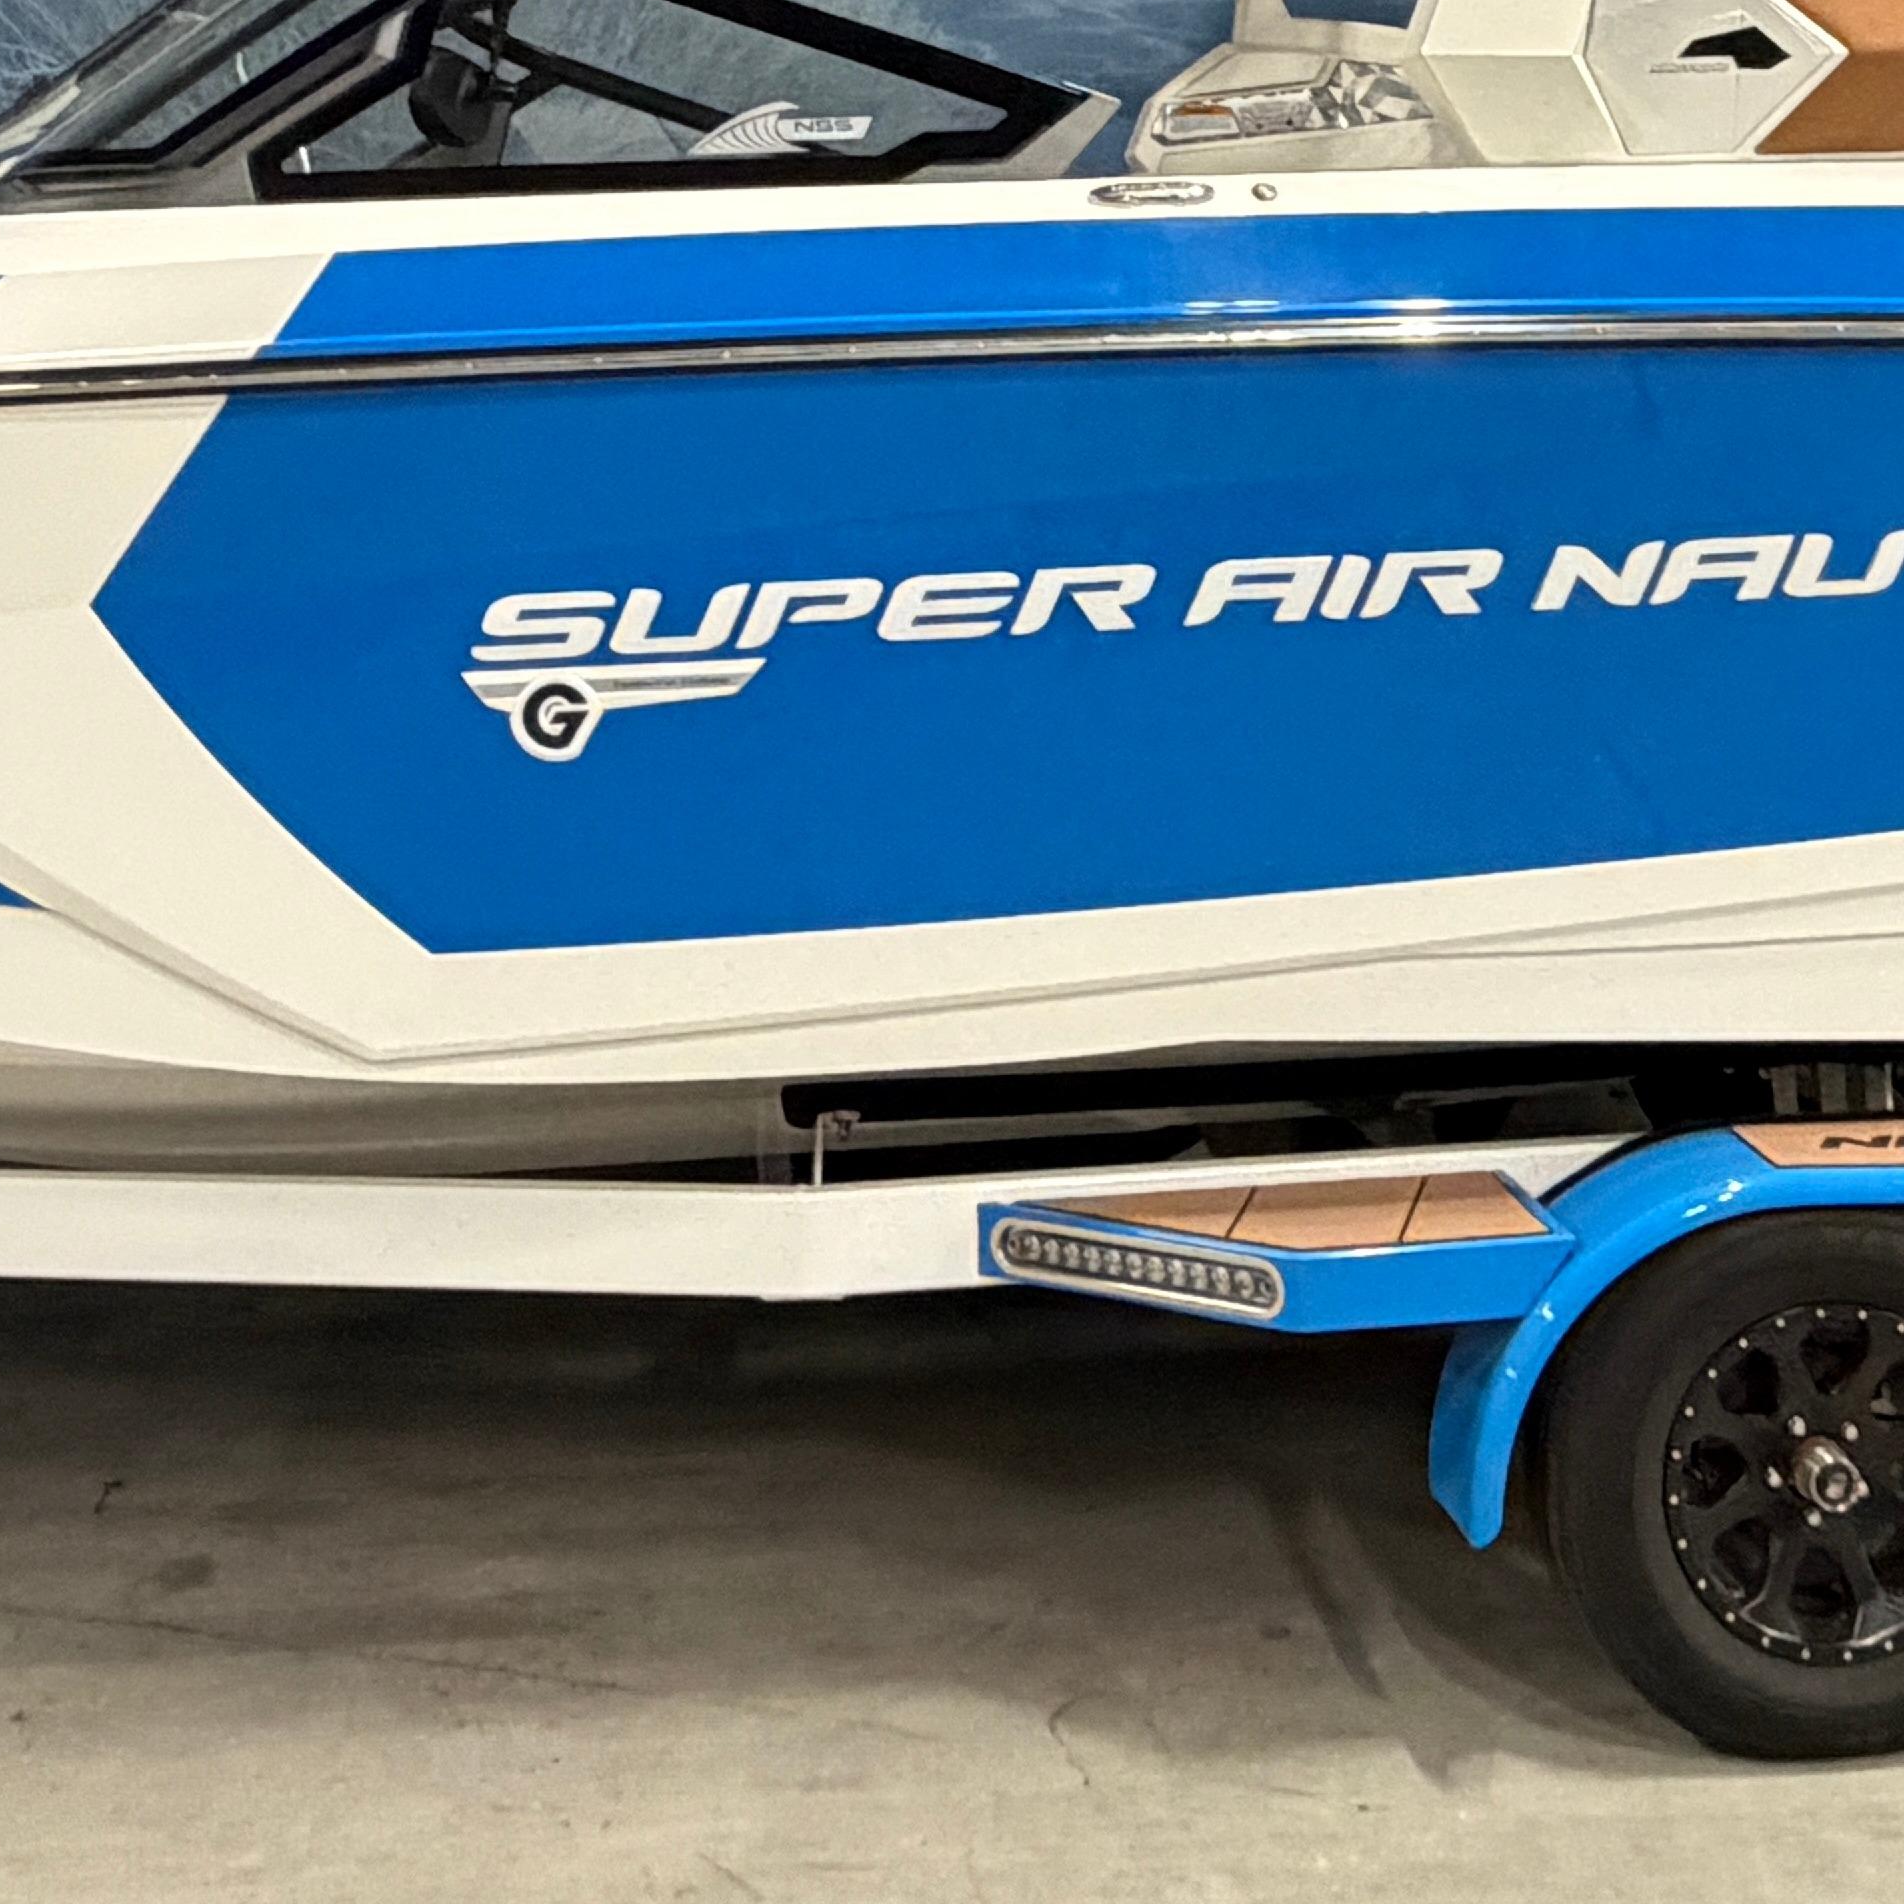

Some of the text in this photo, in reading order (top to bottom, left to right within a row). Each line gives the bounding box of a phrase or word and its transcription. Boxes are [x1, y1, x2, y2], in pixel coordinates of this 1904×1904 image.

[469, 562, 1158, 663] SUPER
[1182, 547, 1505, 628] AIR
[522, 683, 589, 749] G
